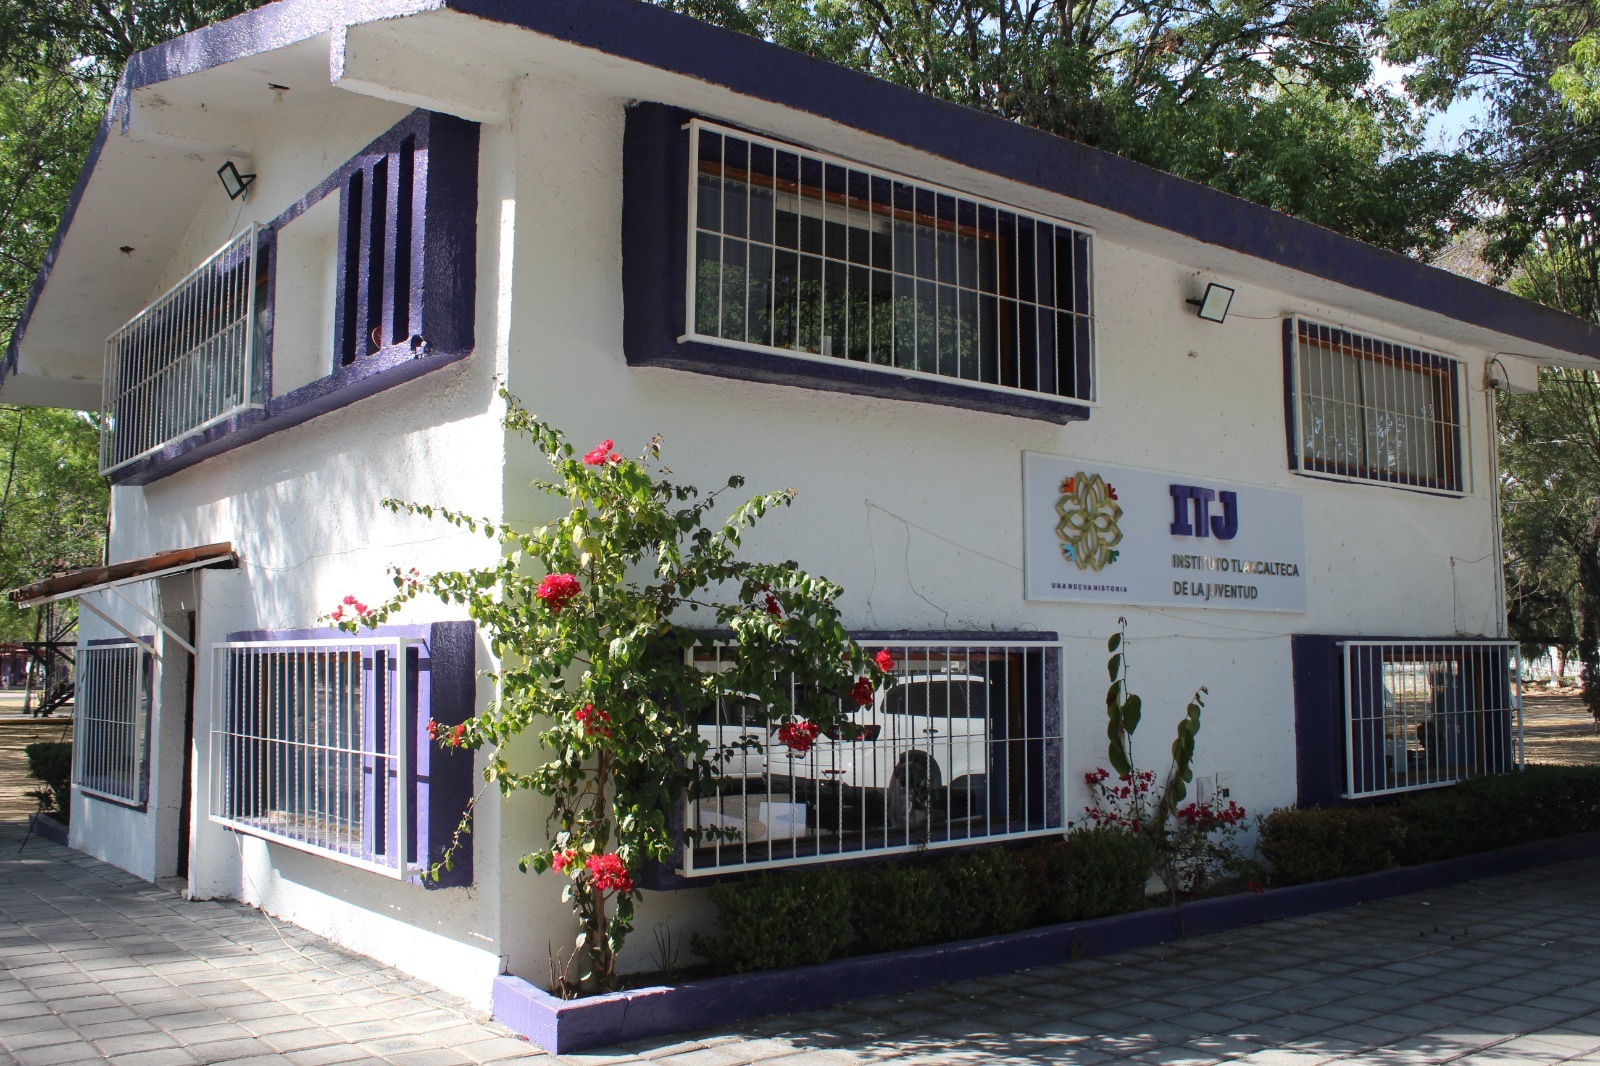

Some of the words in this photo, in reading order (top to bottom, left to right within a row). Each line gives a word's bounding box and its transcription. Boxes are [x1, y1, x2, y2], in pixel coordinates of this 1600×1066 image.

[1169, 484, 1239, 541] ITJ
[1172, 553, 1229, 572] INSTITUTO
[1231, 558, 1300, 577] TLAXCALTECA
[1051, 582, 1067, 590] UNA
[1068, 583, 1092, 591] NUEVA
[1093, 584, 1128, 593] HISTORIA
[1173, 581, 1189, 596] DE
[1191, 582, 1205, 597] LA
[1205, 583, 1258, 601] JUVENTUD
